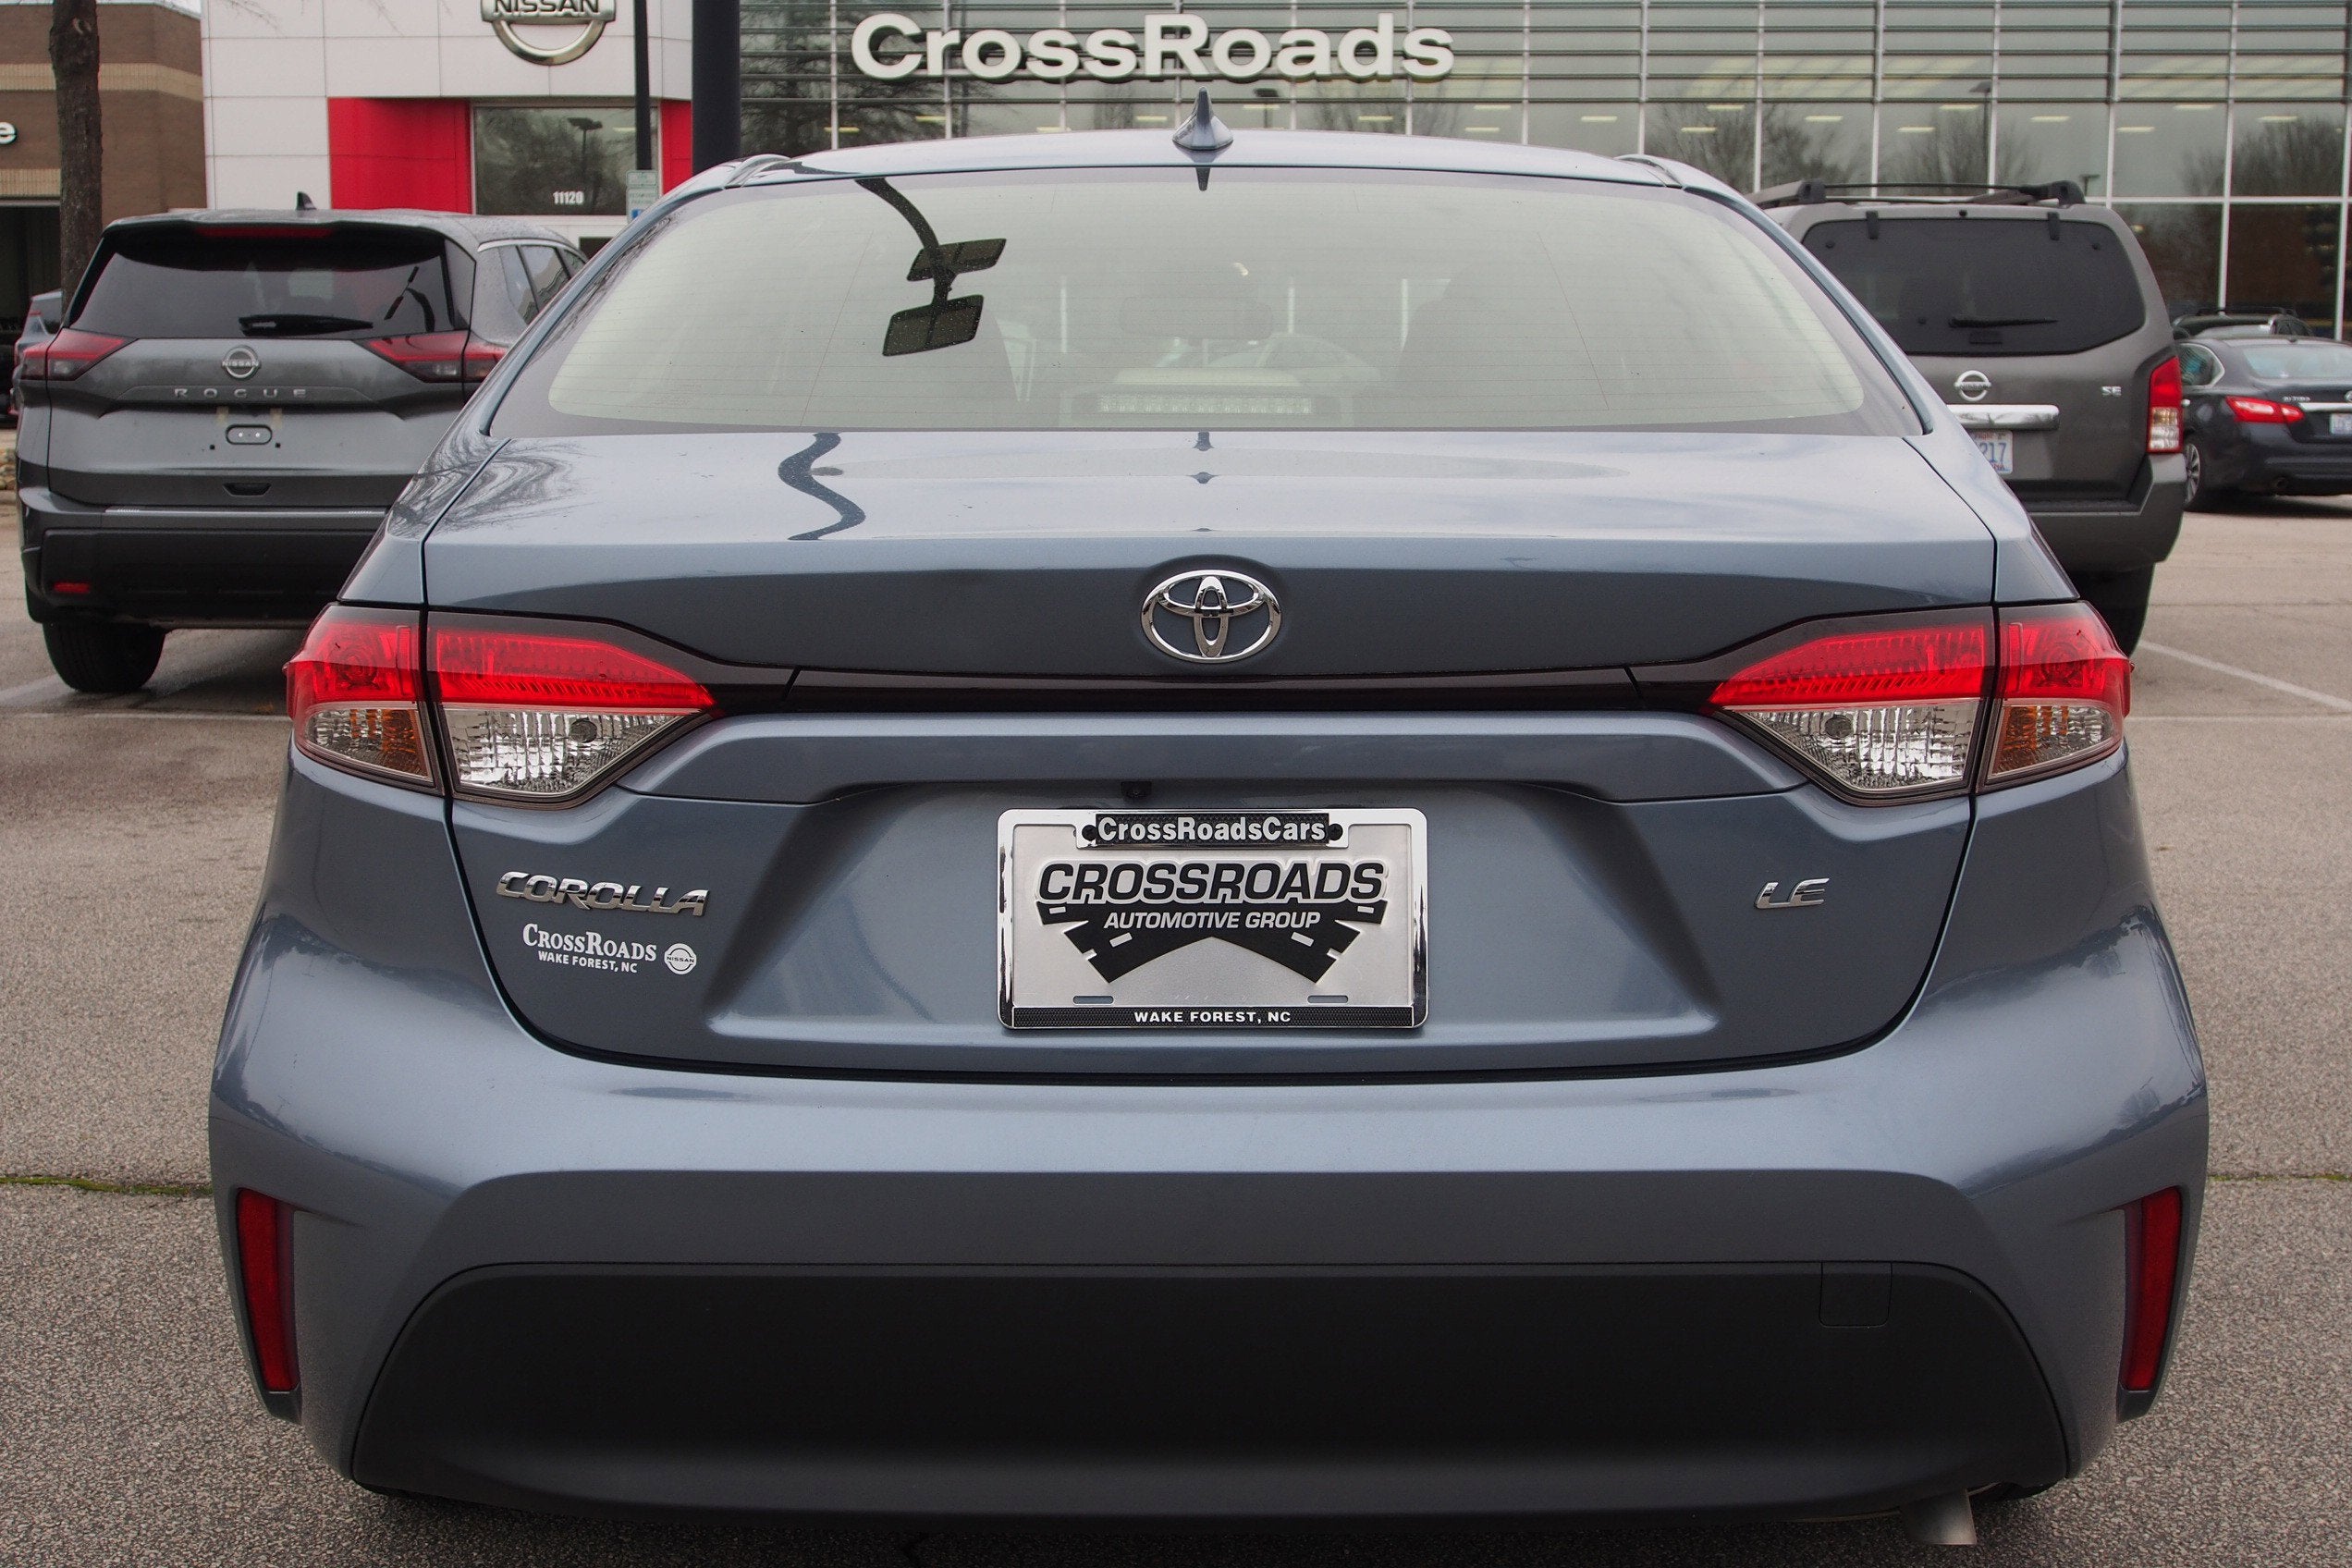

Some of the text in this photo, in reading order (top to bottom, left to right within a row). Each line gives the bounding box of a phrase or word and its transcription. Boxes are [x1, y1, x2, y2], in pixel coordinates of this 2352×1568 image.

[495, 0, 599, 12] NISSAN
[851, 13, 1454, 78] CrossRoads
[553, 190, 584, 204] 11120
[174, 387, 307, 398] ROGUE
[2101, 386, 2122, 397] SE
[1097, 815, 1327, 841] CrossRoadsCars
[1038, 862, 1385, 901] CROSSROADS
[496, 871, 710, 917] COROLLA
[1756, 877, 1830, 909] LE
[1105, 911, 1321, 929] AUTOMOTIVE GROUP
[538, 949, 638, 974] WAKE FOREST, NC
[666, 955, 694, 963] NISSAN
[1133, 1011, 1292, 1024] WAKE FOREST, NC
